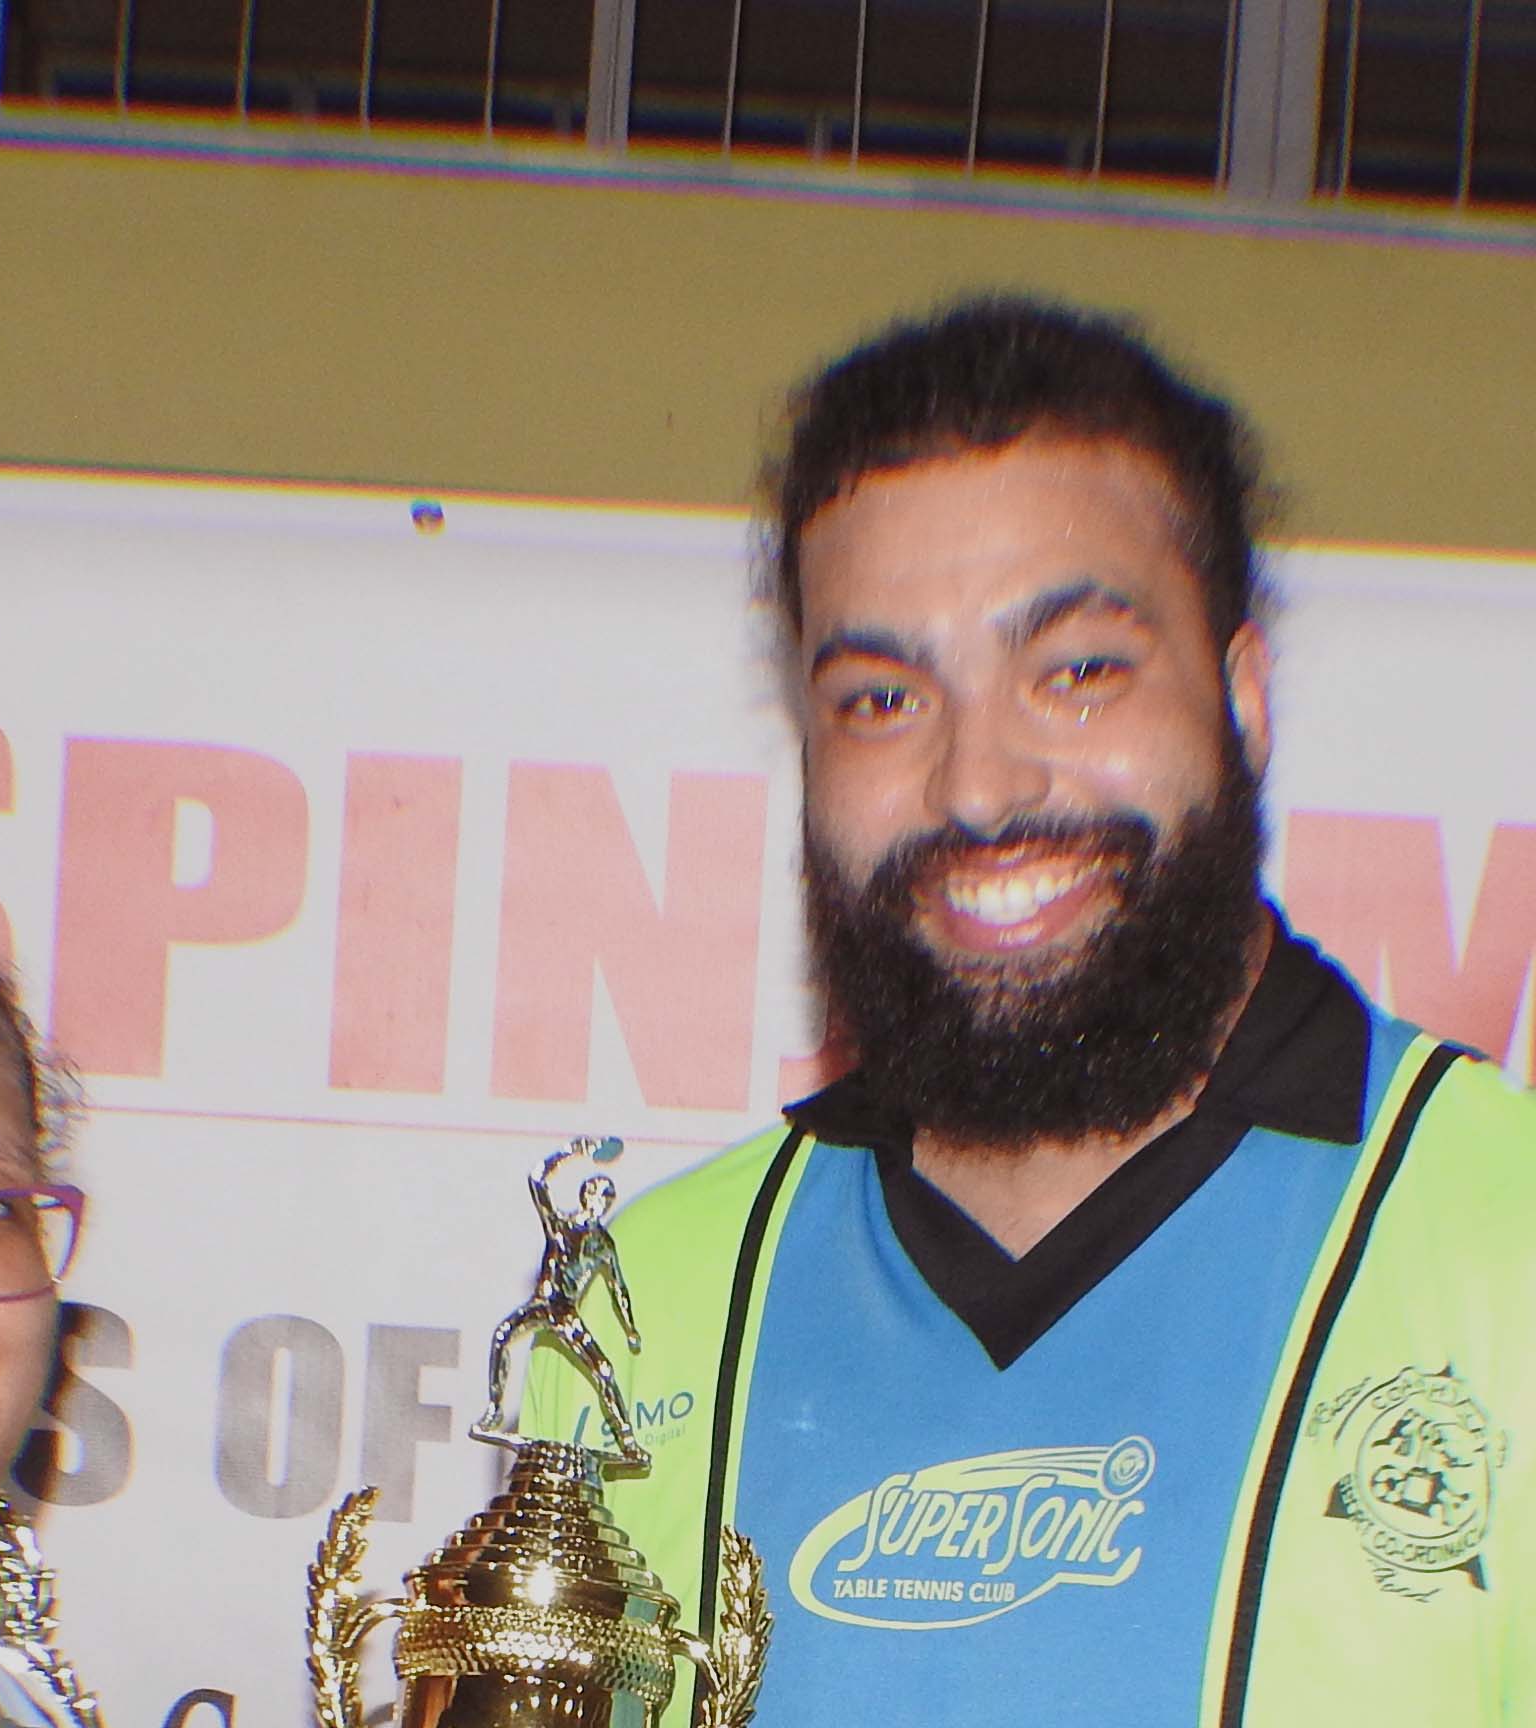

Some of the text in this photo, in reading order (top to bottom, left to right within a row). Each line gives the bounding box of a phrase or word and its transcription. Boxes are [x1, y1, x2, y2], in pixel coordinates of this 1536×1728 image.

[213, 1313, 462, 1524] OF
[833, 1579, 1016, 1602] TABLE TENNIS CLUB
